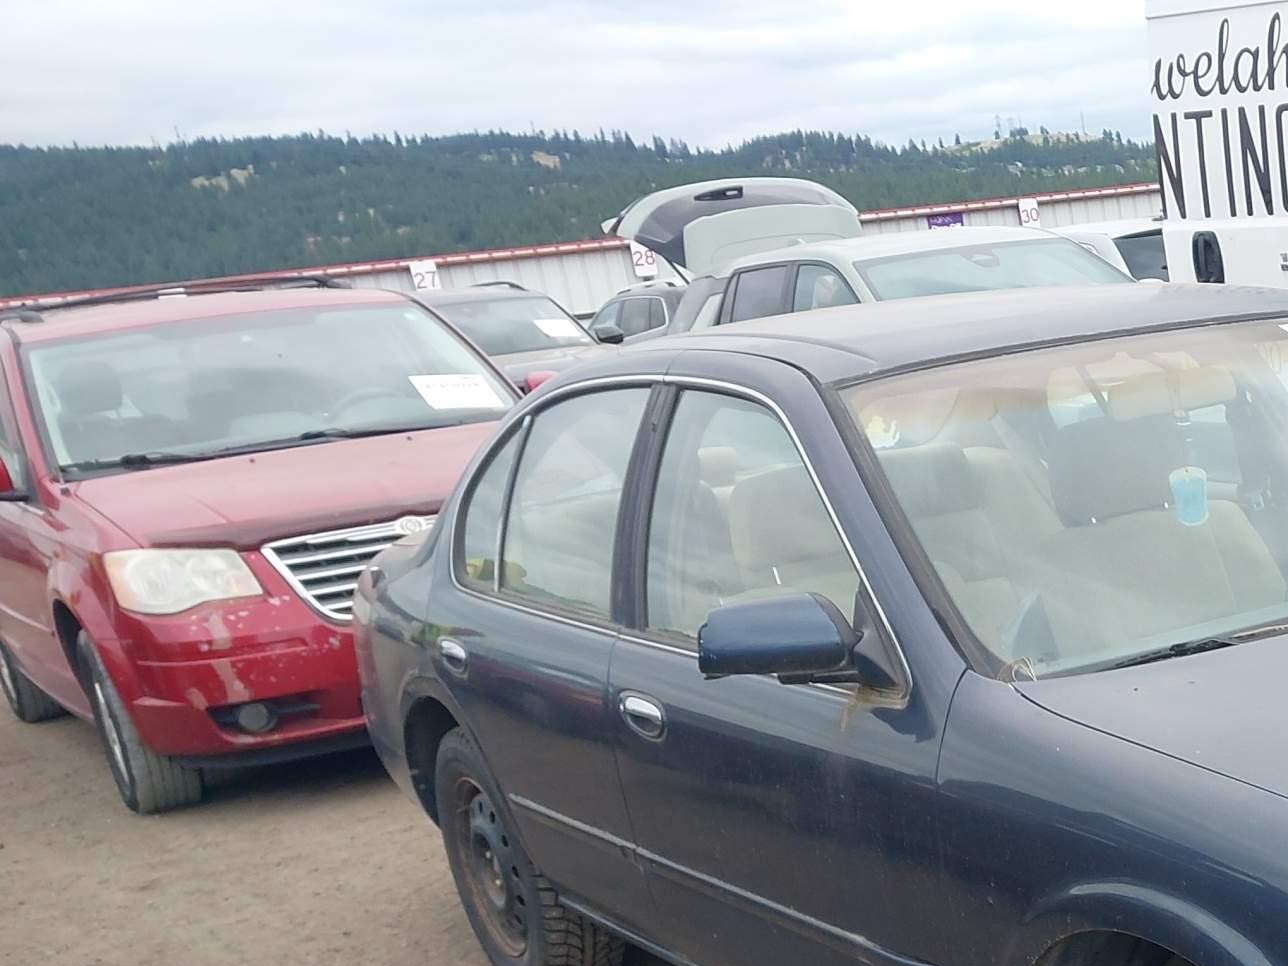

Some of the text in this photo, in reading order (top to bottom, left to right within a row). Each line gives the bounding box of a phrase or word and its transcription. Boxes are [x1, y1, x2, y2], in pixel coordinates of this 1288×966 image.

[1021, 207, 1038, 224] 30
[634, 250, 655, 266] 28
[414, 271, 436, 289] 27
